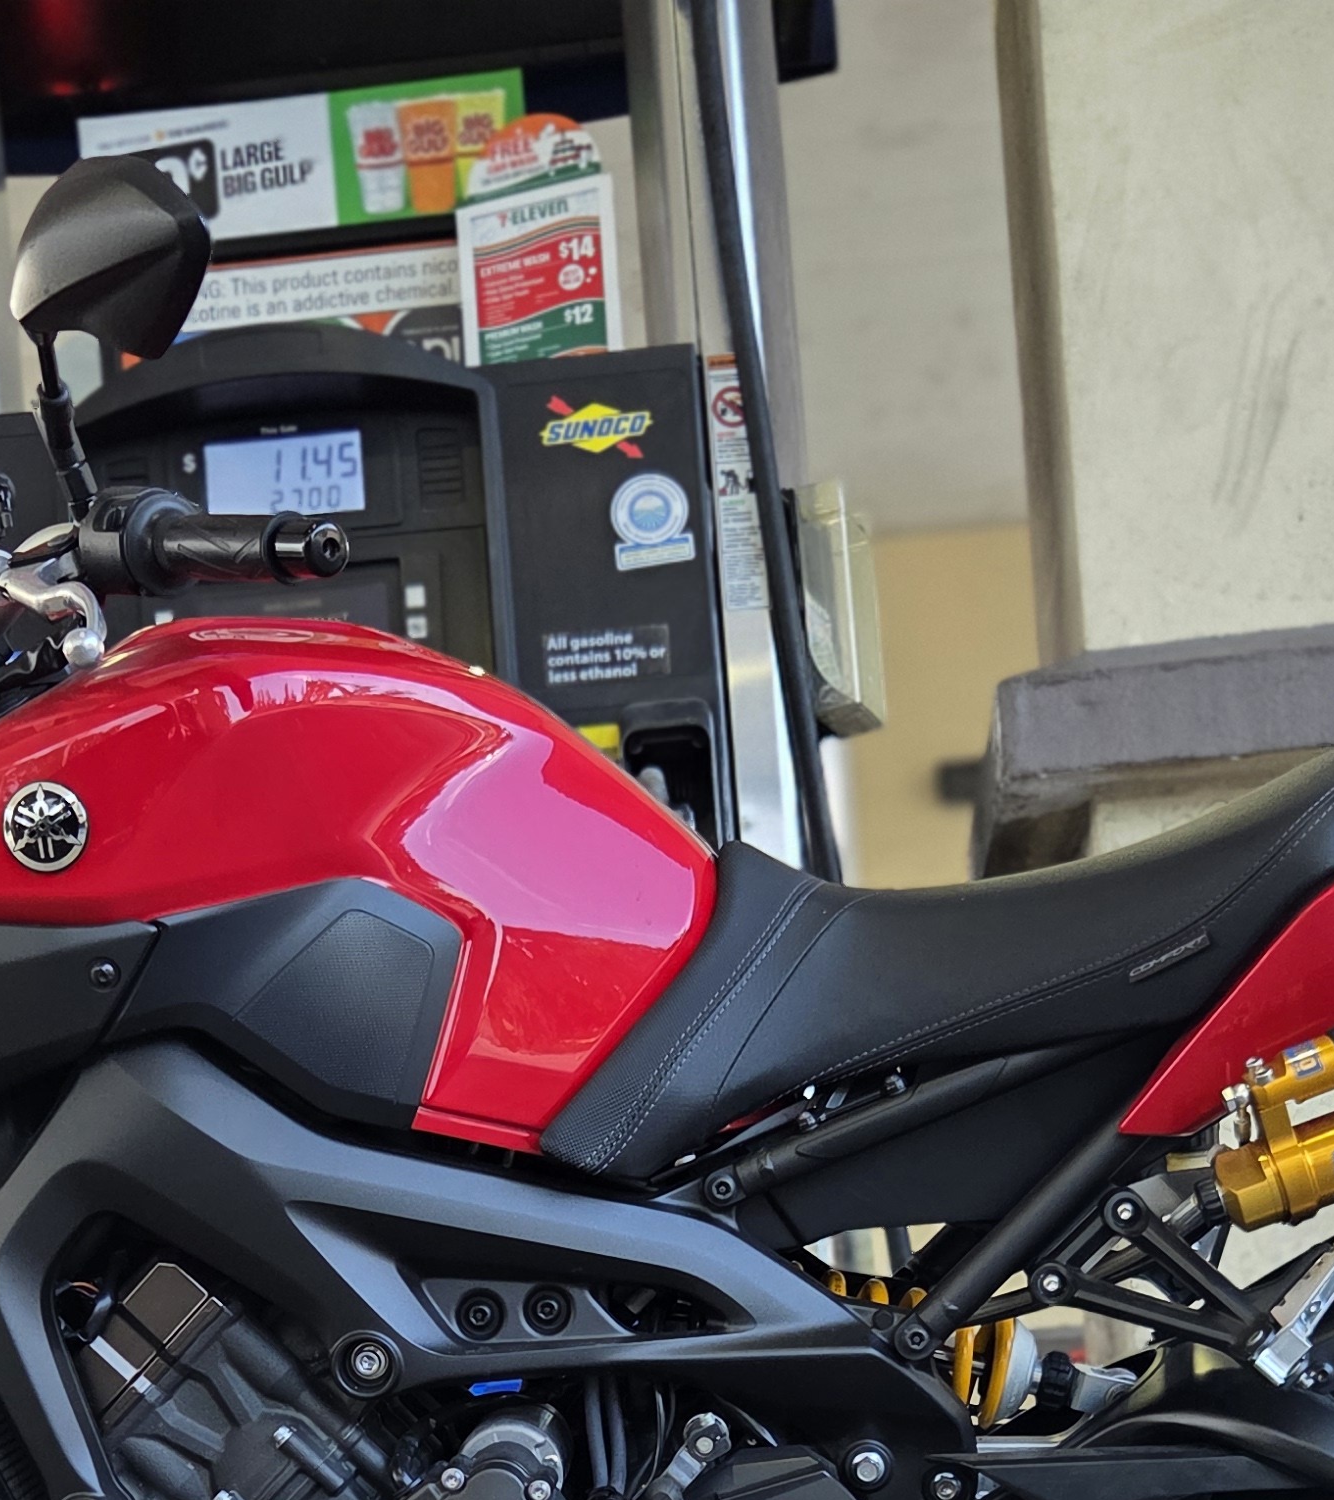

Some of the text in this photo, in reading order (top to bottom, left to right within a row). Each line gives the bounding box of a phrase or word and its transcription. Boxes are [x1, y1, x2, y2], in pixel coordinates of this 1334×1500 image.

[220, 140, 285, 171] LARGE
[222, 170, 257, 199] BIG
[260, 158, 314, 189] GULP
[559, 235, 596, 261] $14
[231, 276, 267, 297] This
[272, 268, 339, 296] product
[343, 262, 418, 285] contains
[480, 259, 521, 278] EXTREME
[246, 298, 262, 318] is
[266, 299, 288, 316] an
[292, 288, 370, 313] addictive
[564, 303, 594, 325] $12
[546, 413, 648, 444] SUNOCO
[547, 631, 634, 652] All gasoline
[548, 646, 666, 667] contains 10% or
[548, 661, 638, 684] less ethanol
